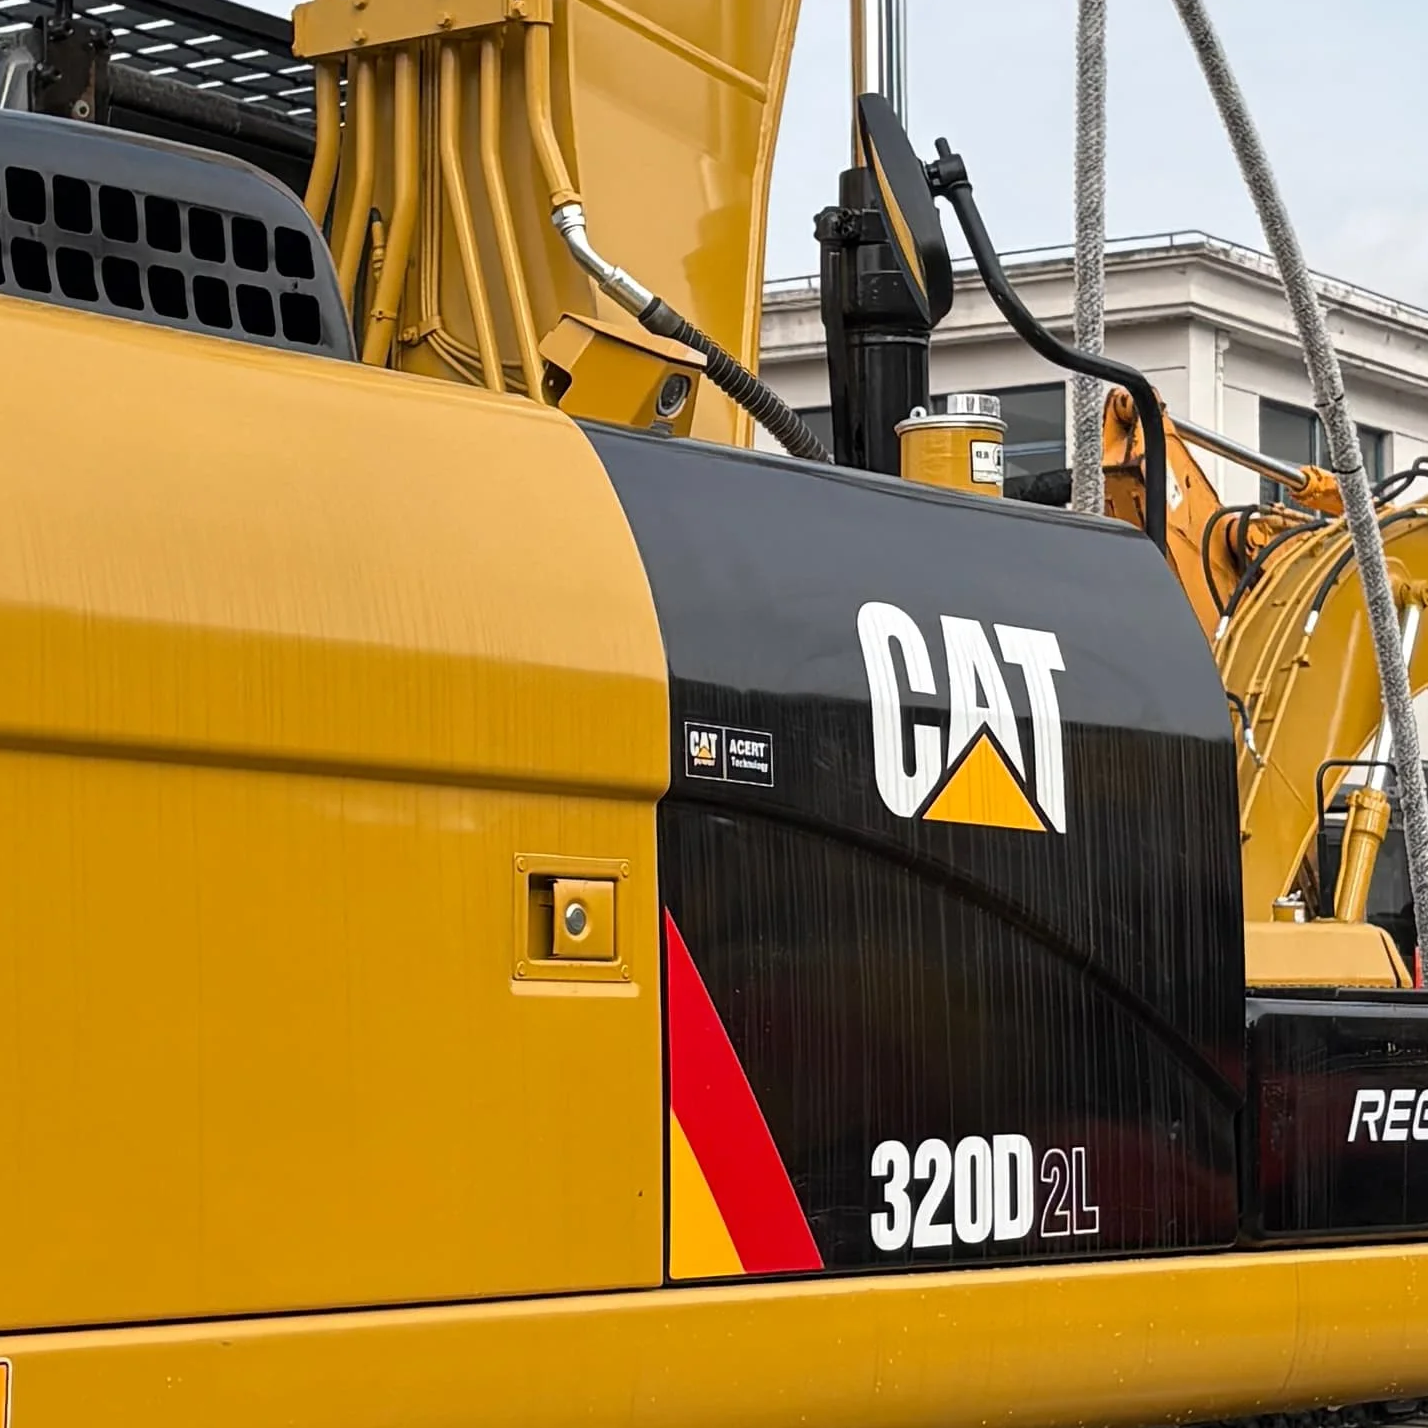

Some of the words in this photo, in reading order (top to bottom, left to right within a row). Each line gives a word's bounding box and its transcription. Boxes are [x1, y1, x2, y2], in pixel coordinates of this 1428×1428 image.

[857, 601, 1067, 835] CAT
[690, 731, 717, 759] CAT
[729, 739, 765, 757] ACERT
[731, 756, 768, 772] Technology
